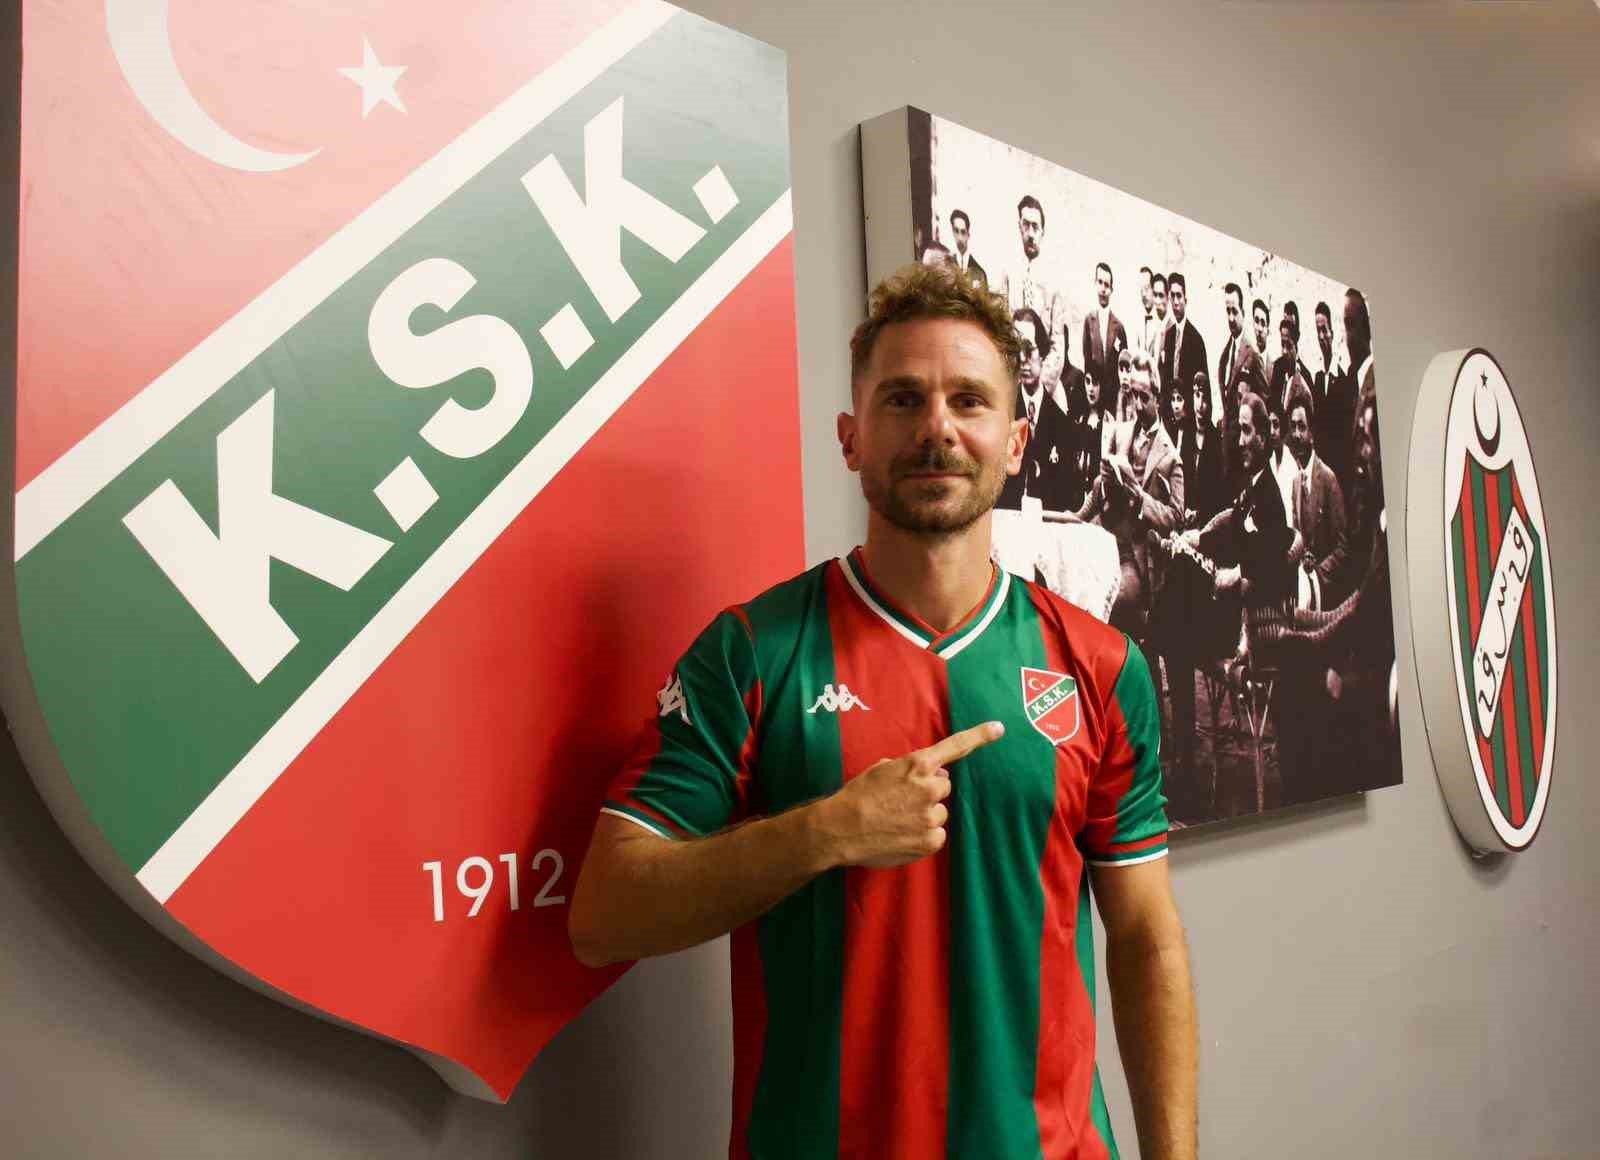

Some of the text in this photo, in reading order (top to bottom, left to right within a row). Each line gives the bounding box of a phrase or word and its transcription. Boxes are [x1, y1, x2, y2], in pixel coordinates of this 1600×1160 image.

[122, 96, 740, 683] K.S.K.
[1031, 686, 1068, 715] K.S.K.
[423, 849, 566, 922] 1912
